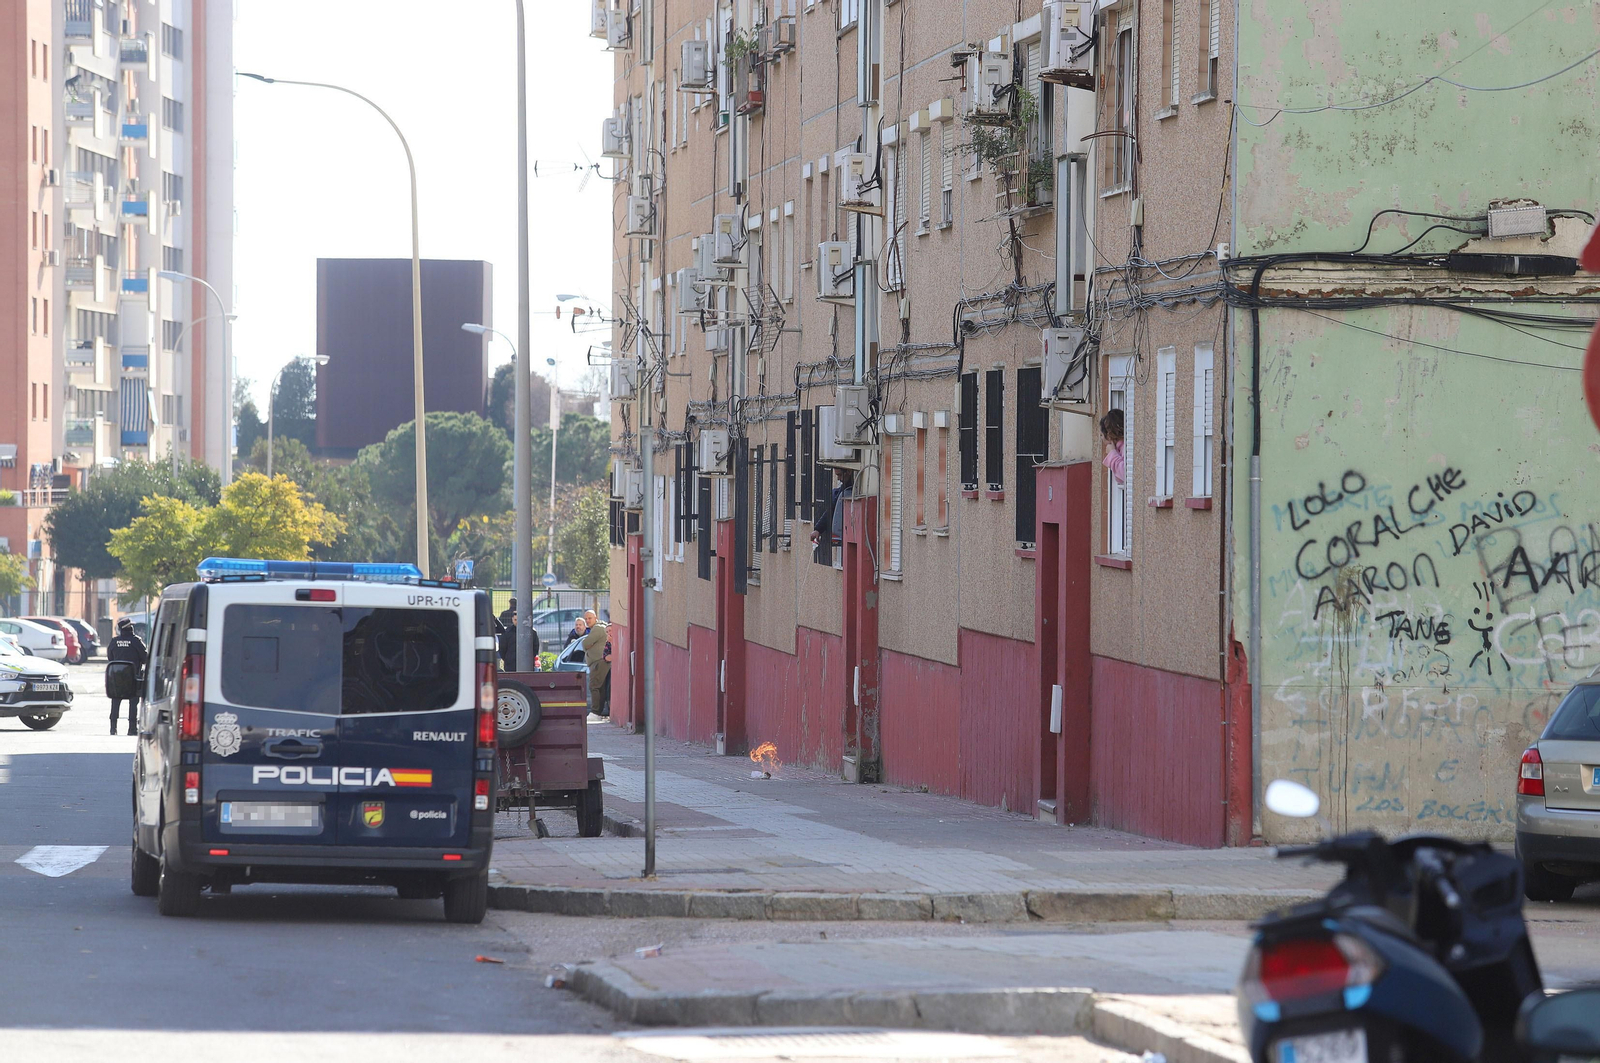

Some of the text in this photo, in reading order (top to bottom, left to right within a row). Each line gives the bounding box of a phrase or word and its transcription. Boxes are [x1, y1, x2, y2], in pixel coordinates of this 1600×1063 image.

[1287, 470, 1366, 531] LOLO
[1449, 490, 1536, 556] DAVID
[1295, 505, 1426, 580] CORAL
[1312, 553, 1440, 620] AARON
[407, 595, 461, 607] UPR-17C
[266, 727, 322, 738] TRAFIC
[412, 730, 468, 742] RENAULT
[252, 765, 397, 787] POLICIA
[409, 809, 448, 820] @policia
